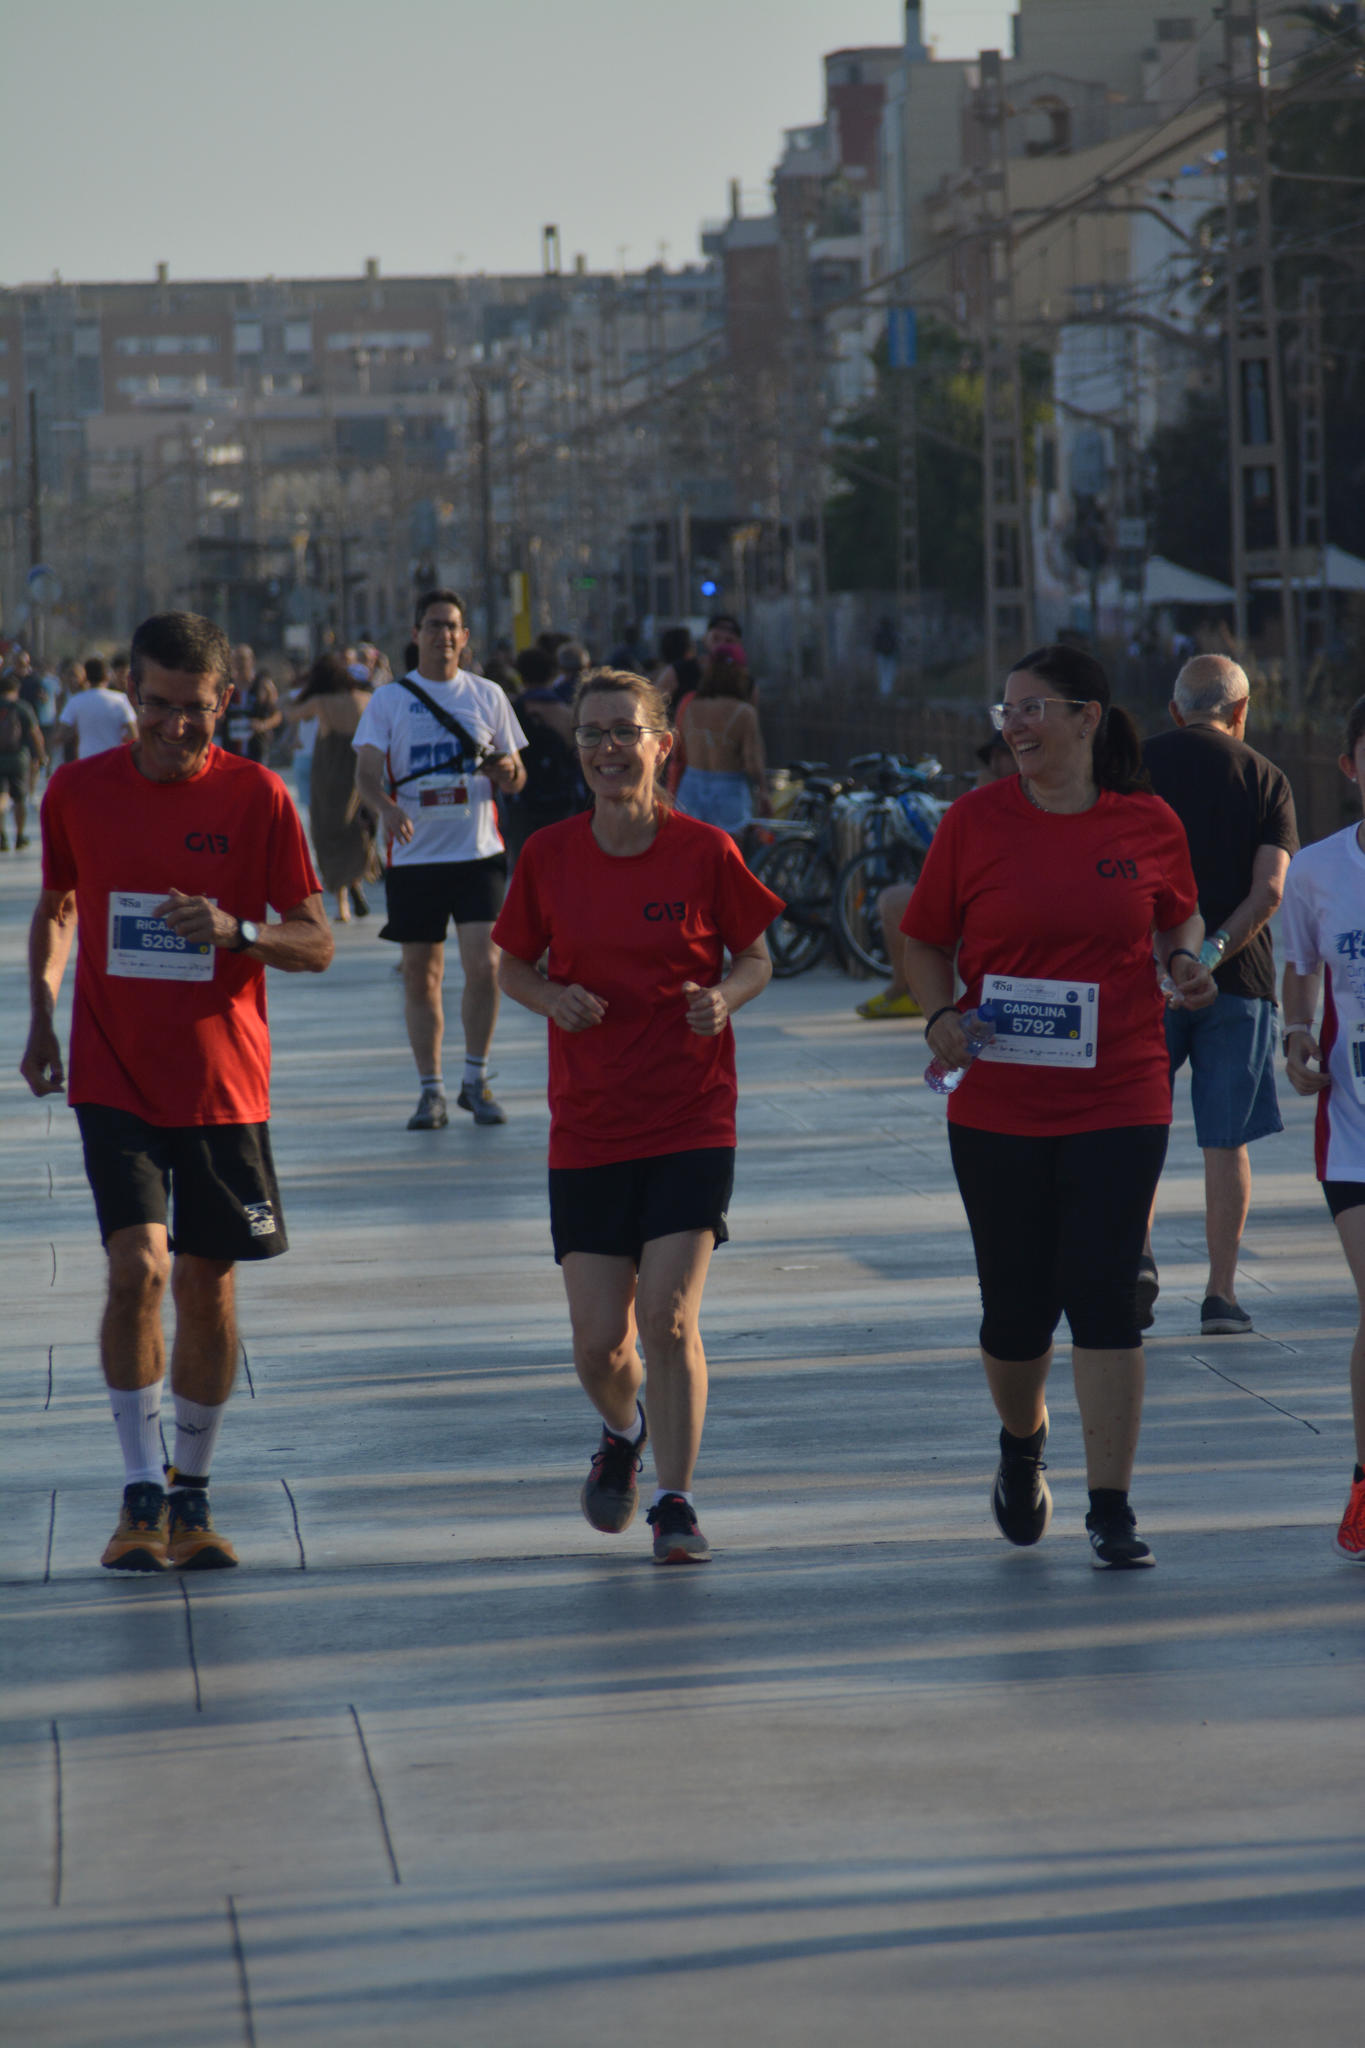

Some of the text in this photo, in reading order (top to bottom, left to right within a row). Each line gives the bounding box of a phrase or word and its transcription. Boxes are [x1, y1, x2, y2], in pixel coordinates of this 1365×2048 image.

[142, 933, 186, 950] 5263
[1002, 1003, 1067, 1018] CAROLINA
[1012, 1018, 1056, 1035] 5792
